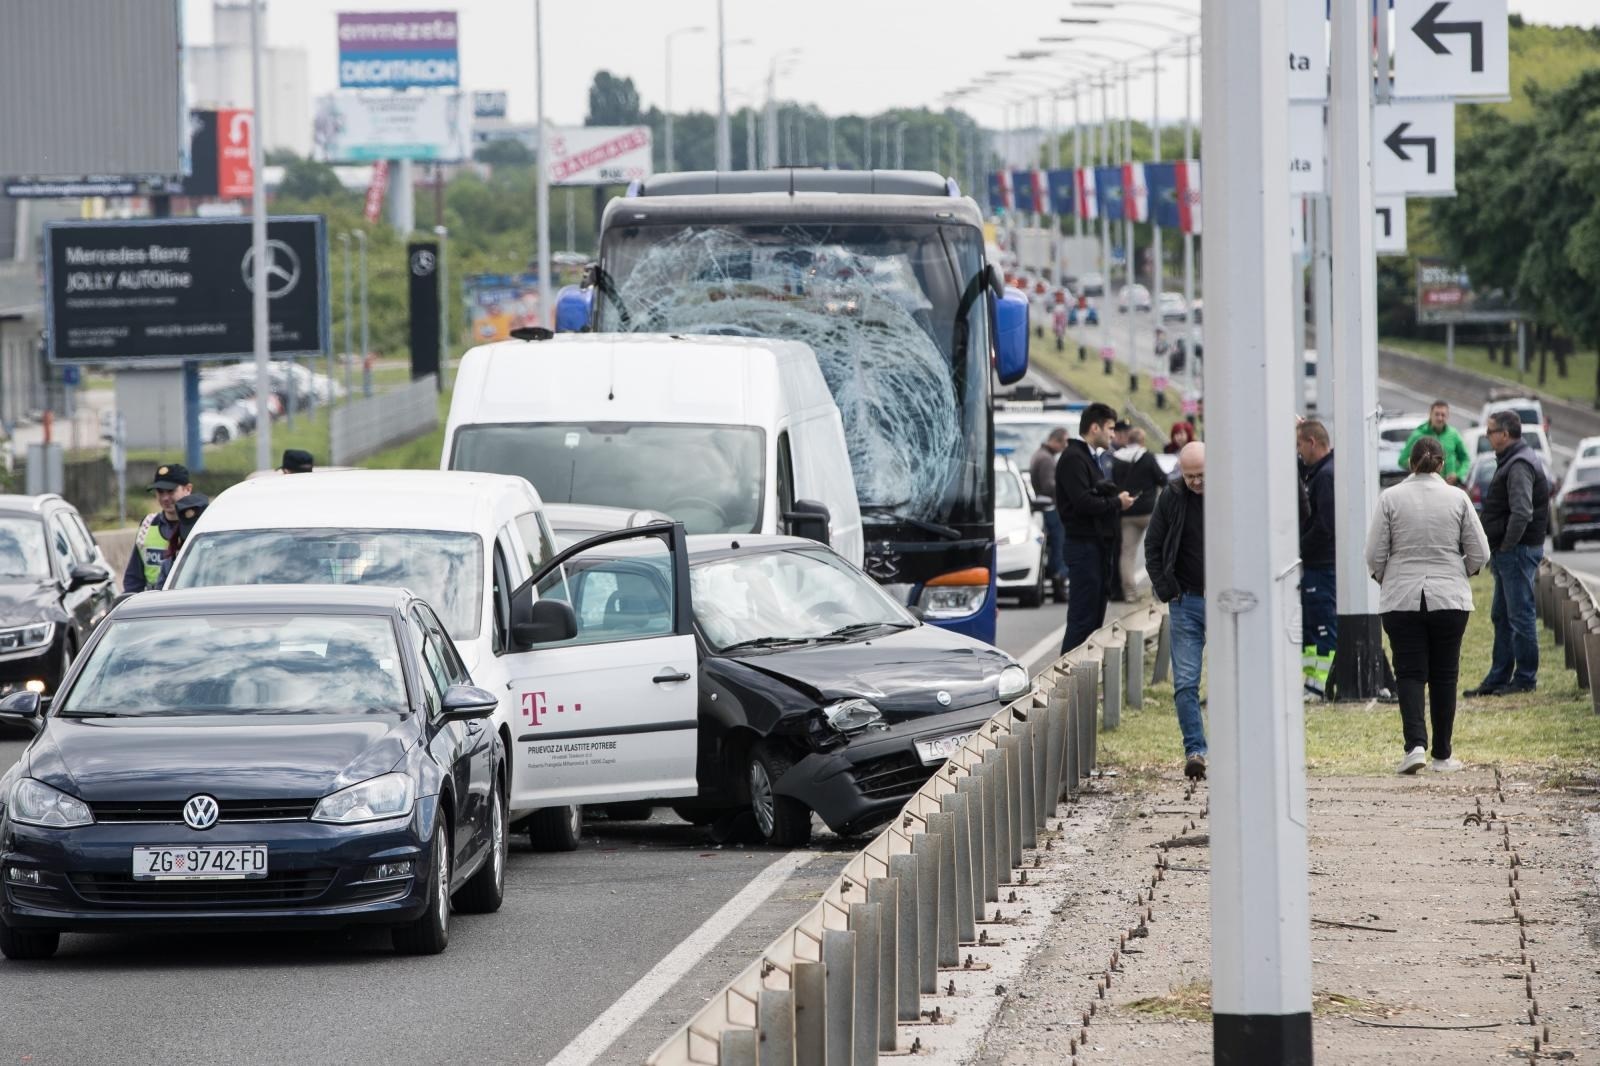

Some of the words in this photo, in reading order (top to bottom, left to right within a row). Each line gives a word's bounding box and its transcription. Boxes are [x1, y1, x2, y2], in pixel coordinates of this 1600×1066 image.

[339, 20, 457, 41] emmezeta
[340, 59, 459, 82] DECATHLON
[66, 271, 114, 292] JOLLY
[555, 744, 563, 752] ZA
[564, 742, 590, 752] VLASTITE
[591, 741, 617, 751] POTREBE
[149, 852, 173, 872] ZG
